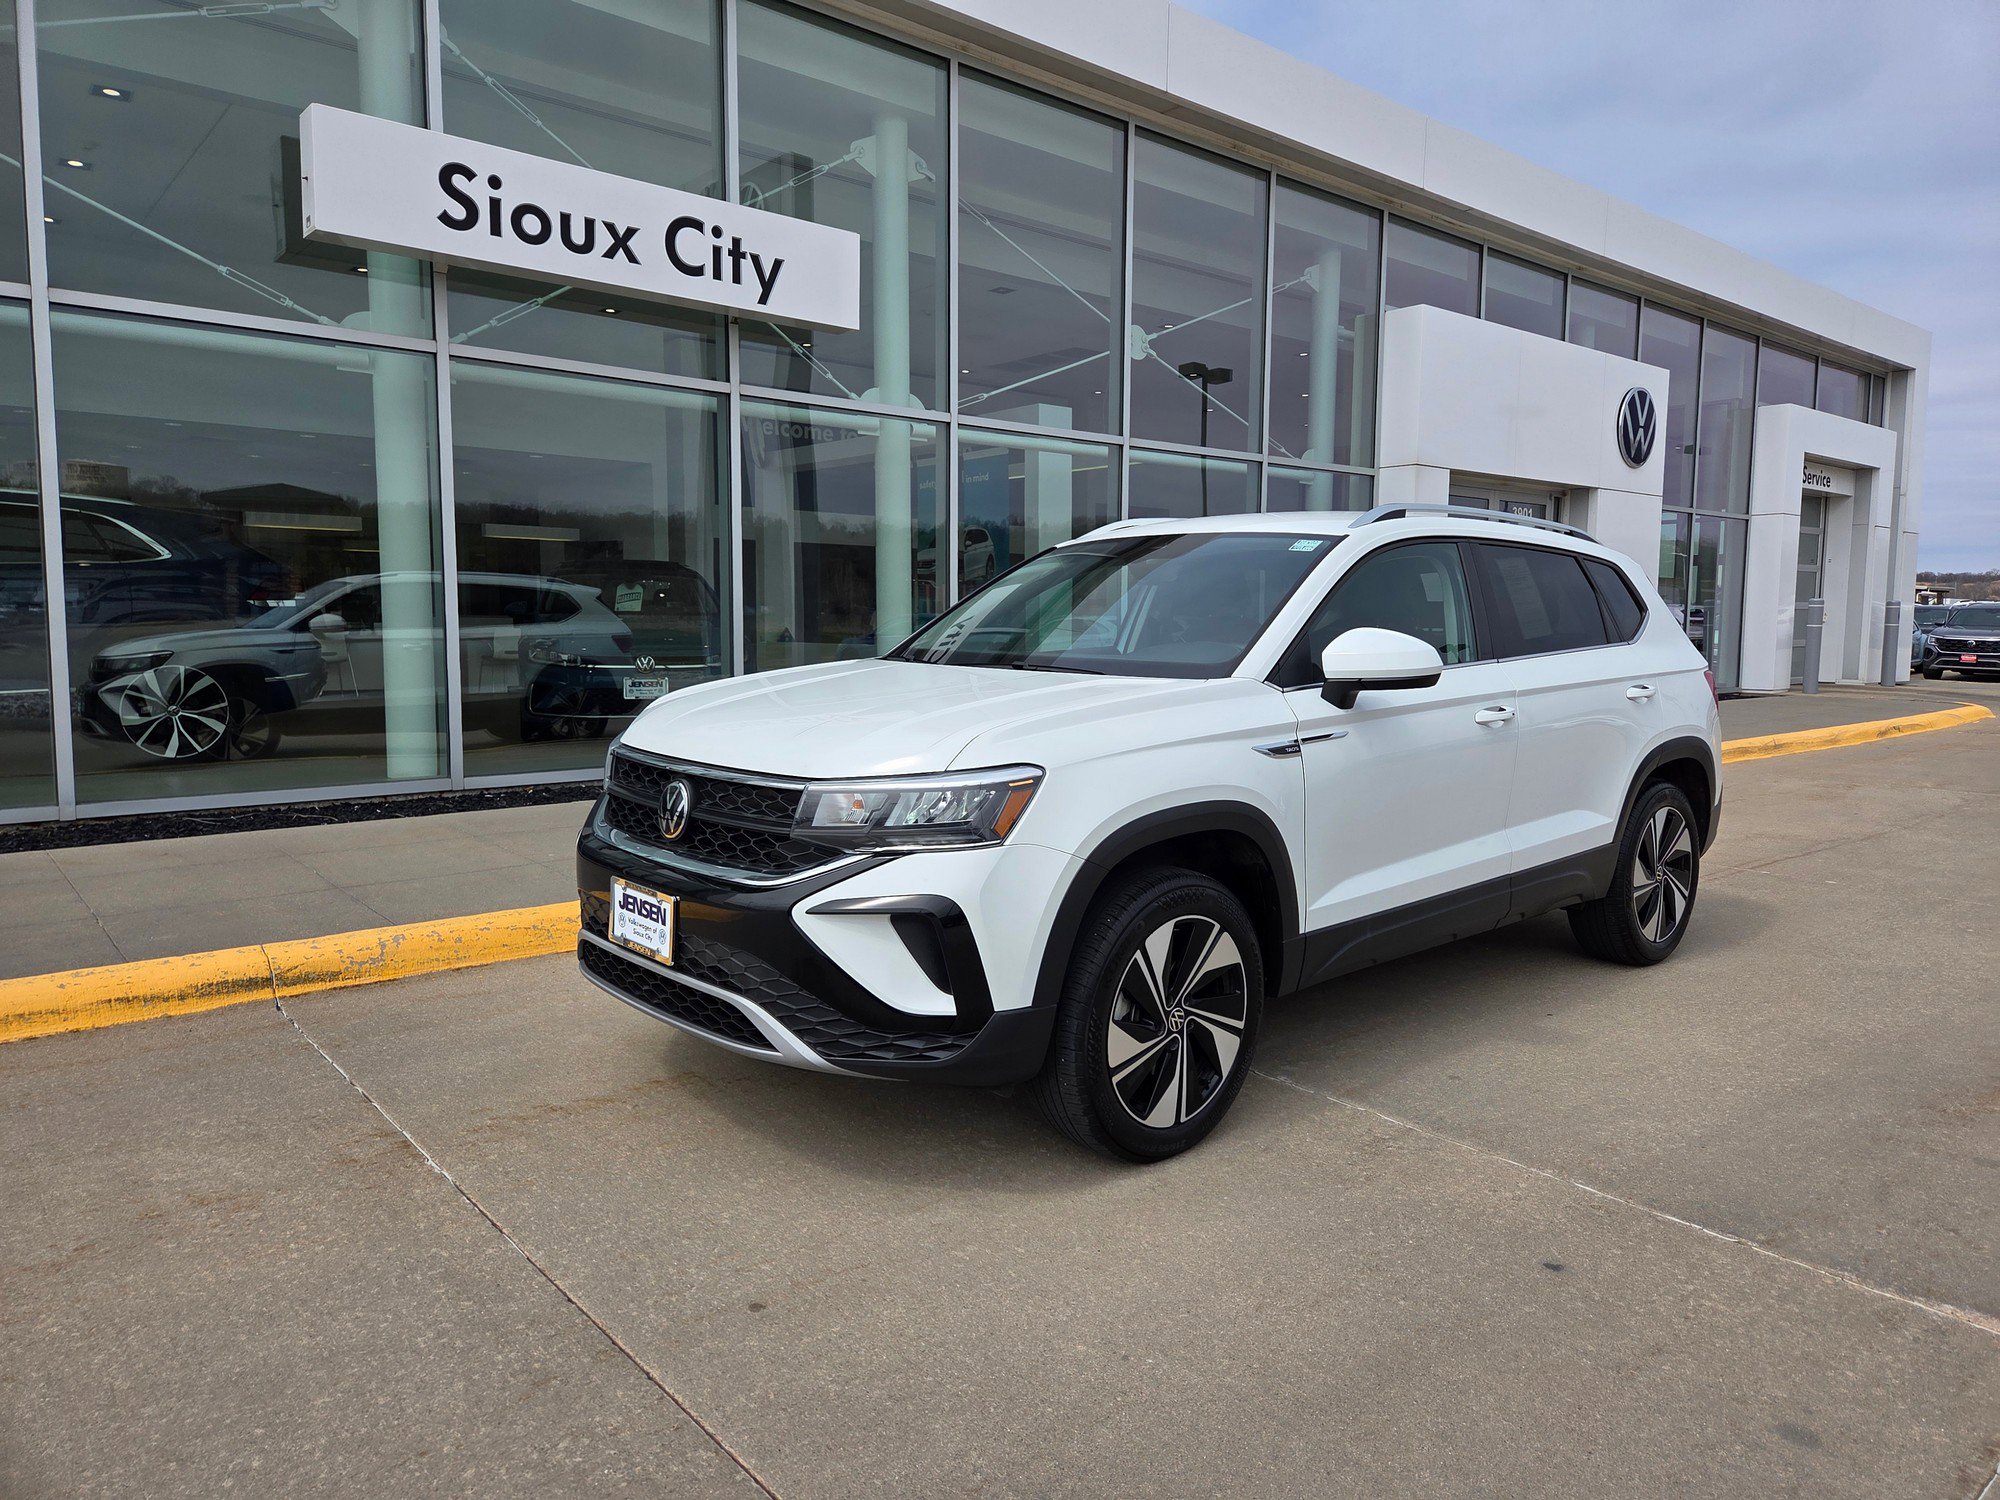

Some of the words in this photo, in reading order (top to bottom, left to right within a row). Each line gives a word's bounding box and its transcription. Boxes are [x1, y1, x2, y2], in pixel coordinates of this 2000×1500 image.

[437, 162, 642, 266] Sioux
[664, 215, 785, 305] City
[1802, 465, 1831, 488] Service
[618, 892, 667, 927] JENSEN
[628, 916, 652, 933] Volkswagen
[633, 928, 645, 939] Sioux
[628, 941, 651, 956] JENSEN
